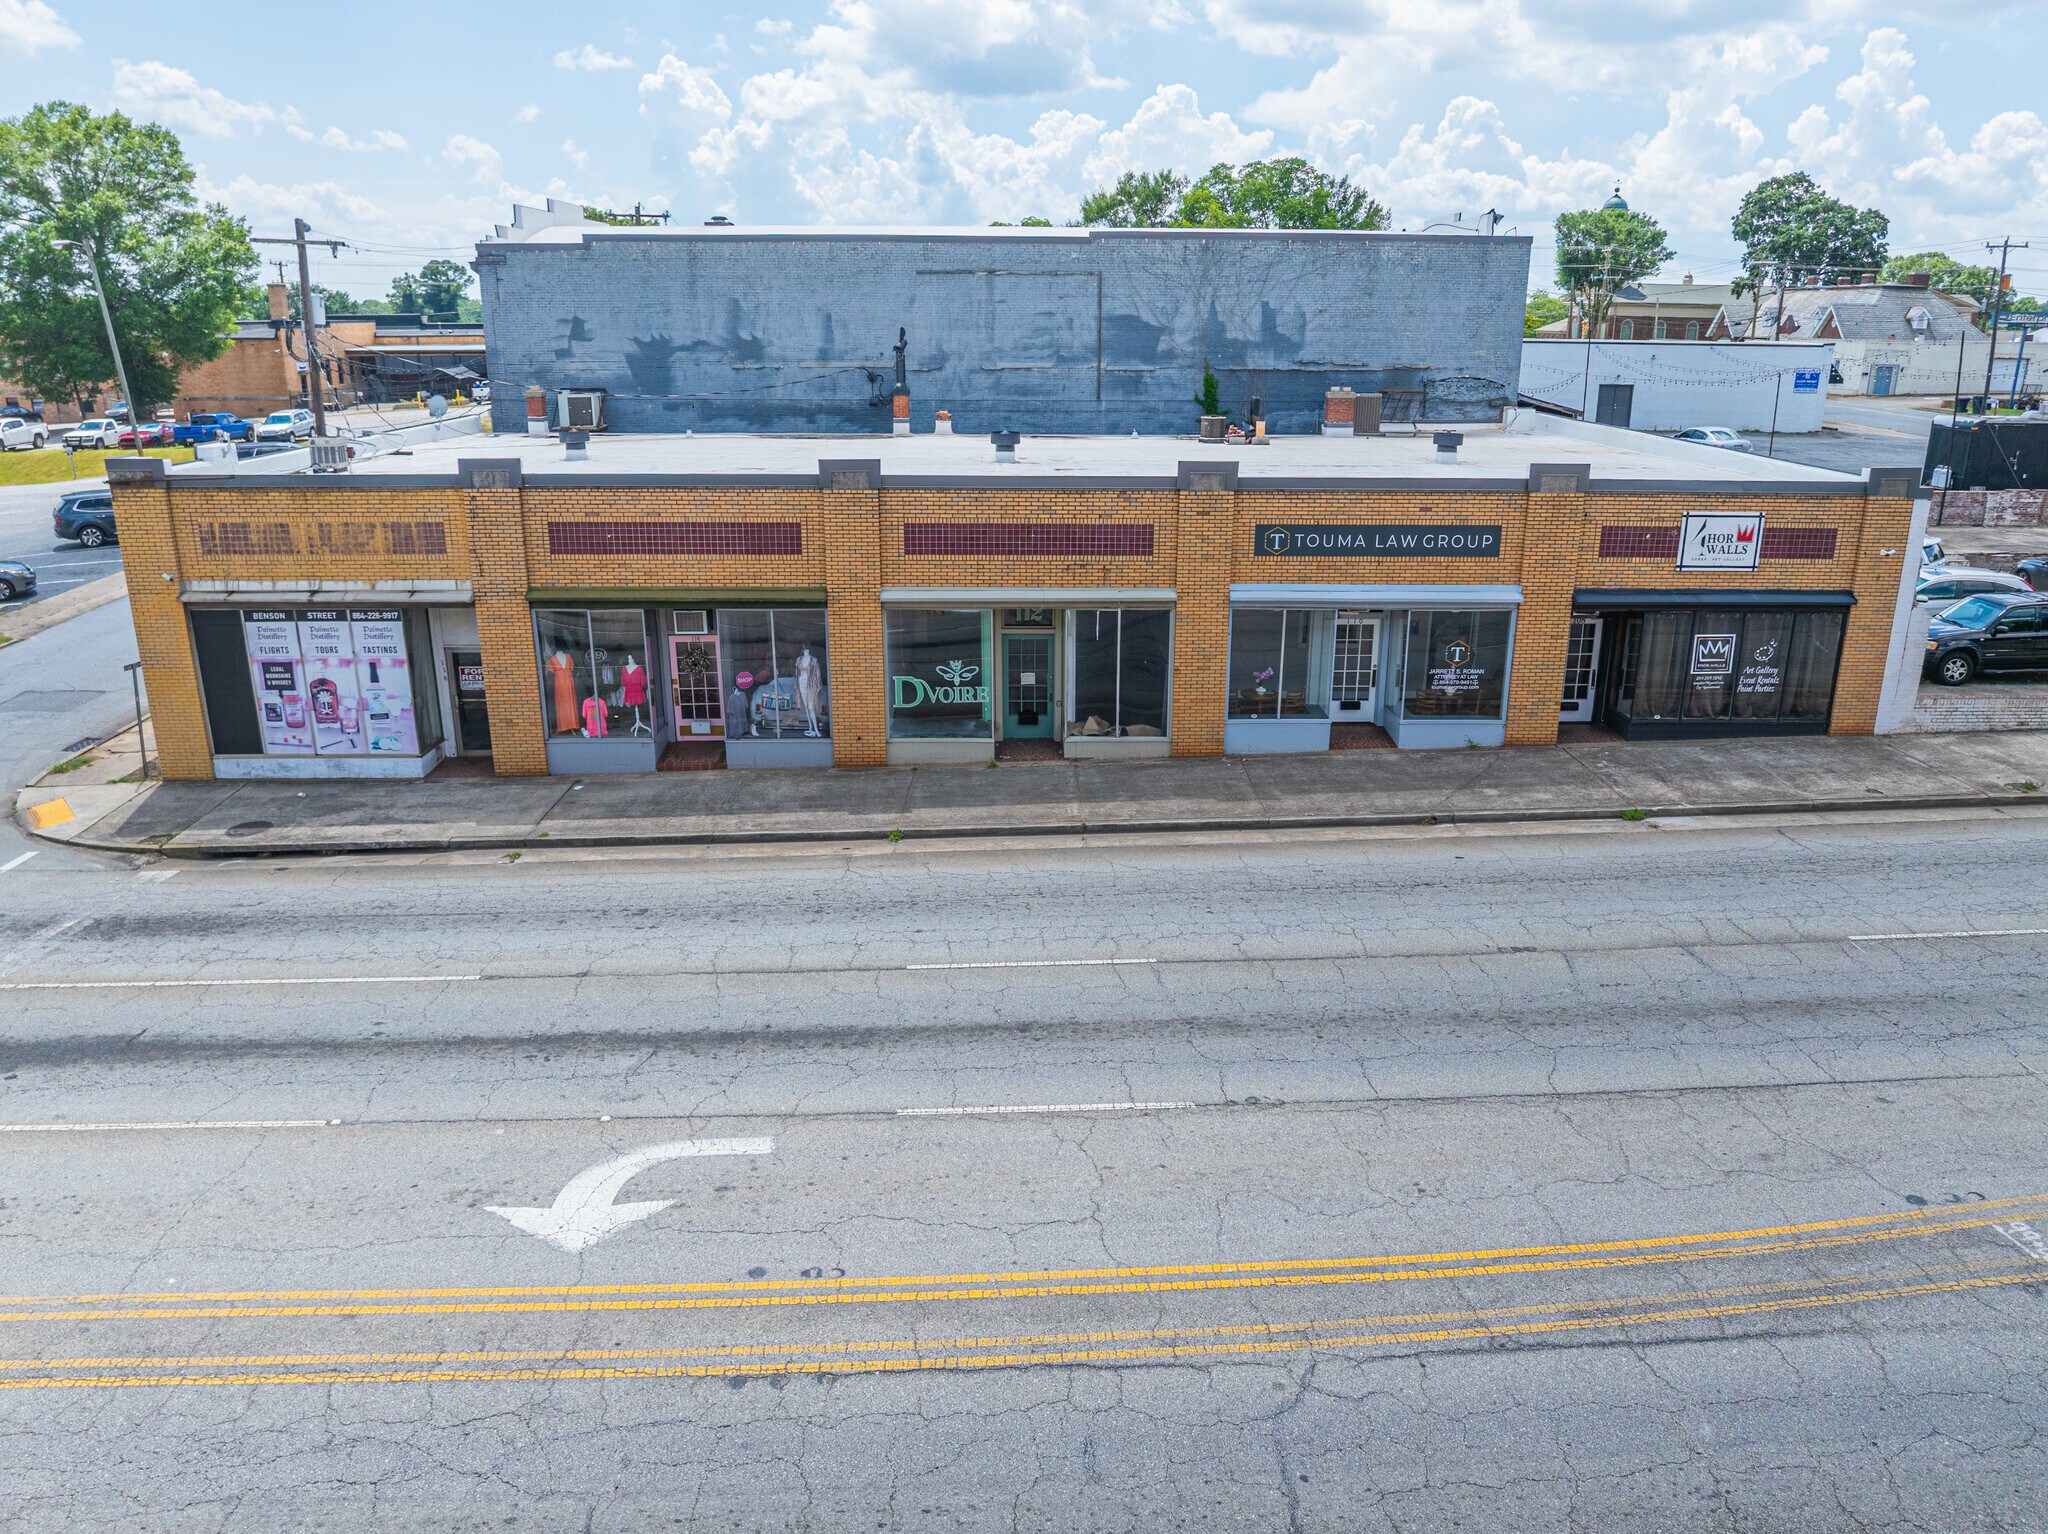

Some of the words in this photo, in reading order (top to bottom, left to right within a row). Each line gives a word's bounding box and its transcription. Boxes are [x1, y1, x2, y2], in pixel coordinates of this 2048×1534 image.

[1270, 533, 1285, 550] T
[1294, 533, 1366, 548] TOUMA
[1375, 534, 1418, 548] LAW
[1422, 534, 1493, 548] GROUP
[1706, 544, 1748, 555] WALLS
[252, 612, 286, 620] BENSON
[256, 625, 287, 633] Palmetto
[309, 625, 340, 633] Palmetto
[362, 625, 393, 633] Palmetto
[257, 632, 288, 641] Distillery
[310, 632, 341, 641] Distillery
[363, 632, 394, 641] Distillery
[315, 646, 339, 654] TOURS
[362, 646, 398, 654] TASTINGS
[1450, 646, 1465, 662] T
[1742, 666, 1755, 674] Art
[1755, 666, 1779, 677] Gallery
[1739, 676, 1756, 684] Event
[1757, 675, 1780, 685] Rentals
[893, 675, 989, 708] DVOIRE
[1736, 684, 1754, 693] Paint
[1754, 684, 1775, 692] Parties
